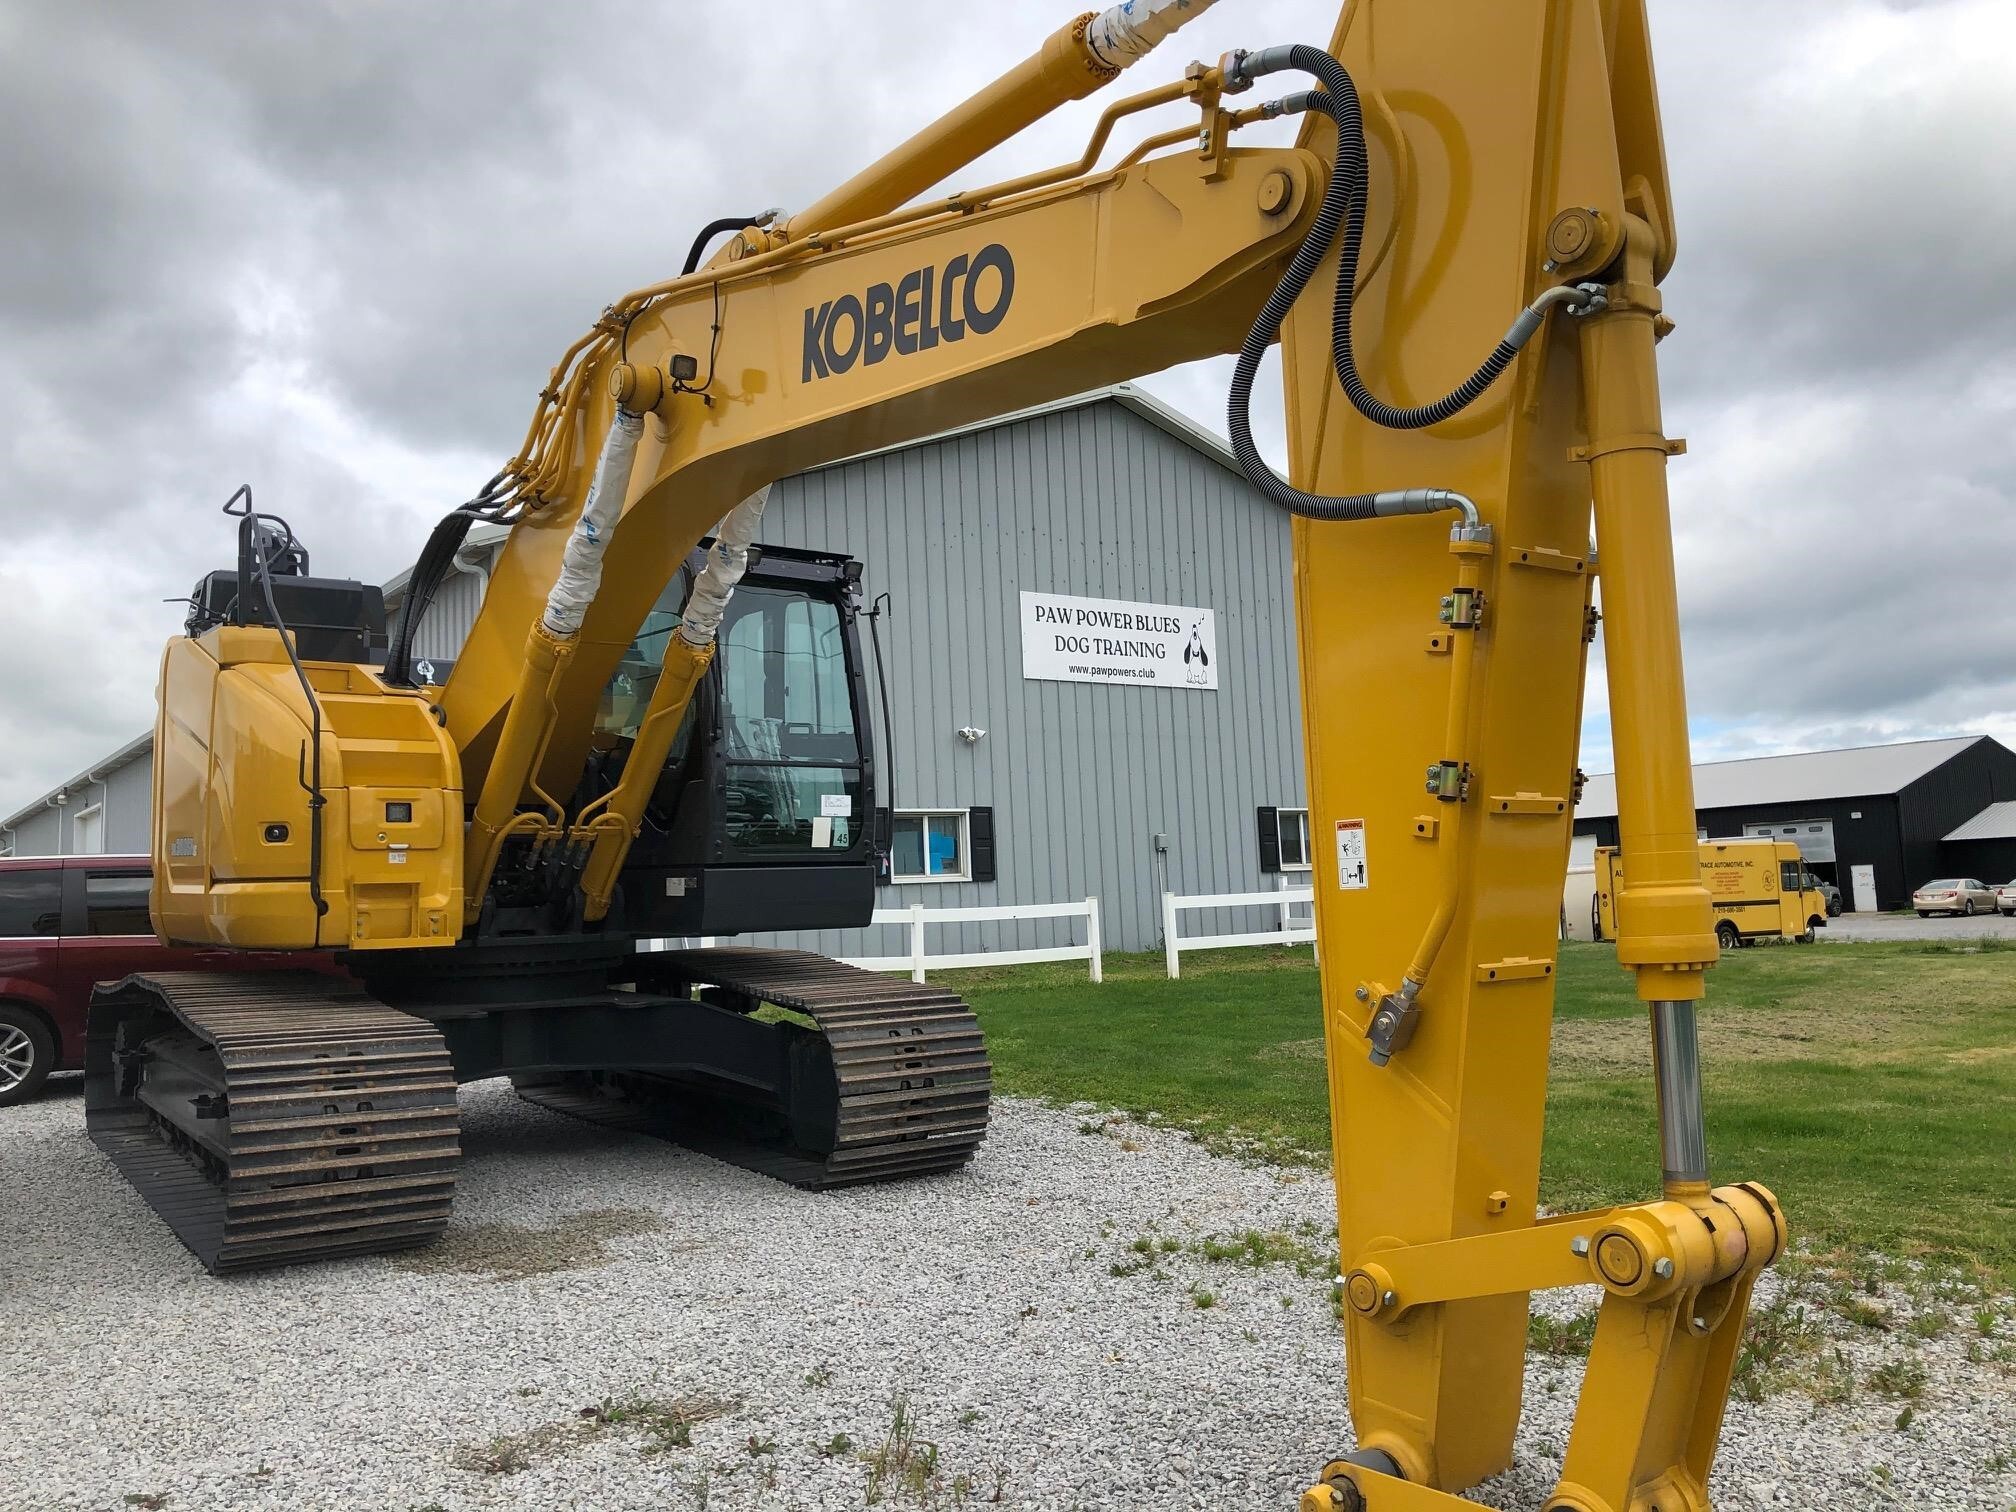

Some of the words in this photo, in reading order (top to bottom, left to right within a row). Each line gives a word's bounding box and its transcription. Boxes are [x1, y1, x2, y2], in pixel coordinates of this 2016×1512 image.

[801, 243, 1015, 384] KOBELCO
[1035, 605, 1073, 624] PAW
[1076, 609, 1133, 630] POWER
[1136, 614, 1181, 634] BLUES
[1054, 635, 1090, 654] DOG
[1093, 638, 1166, 660] TRAINING
[1068, 665, 1156, 679] www.pawpowers.club
[836, 833, 848, 844] 45
